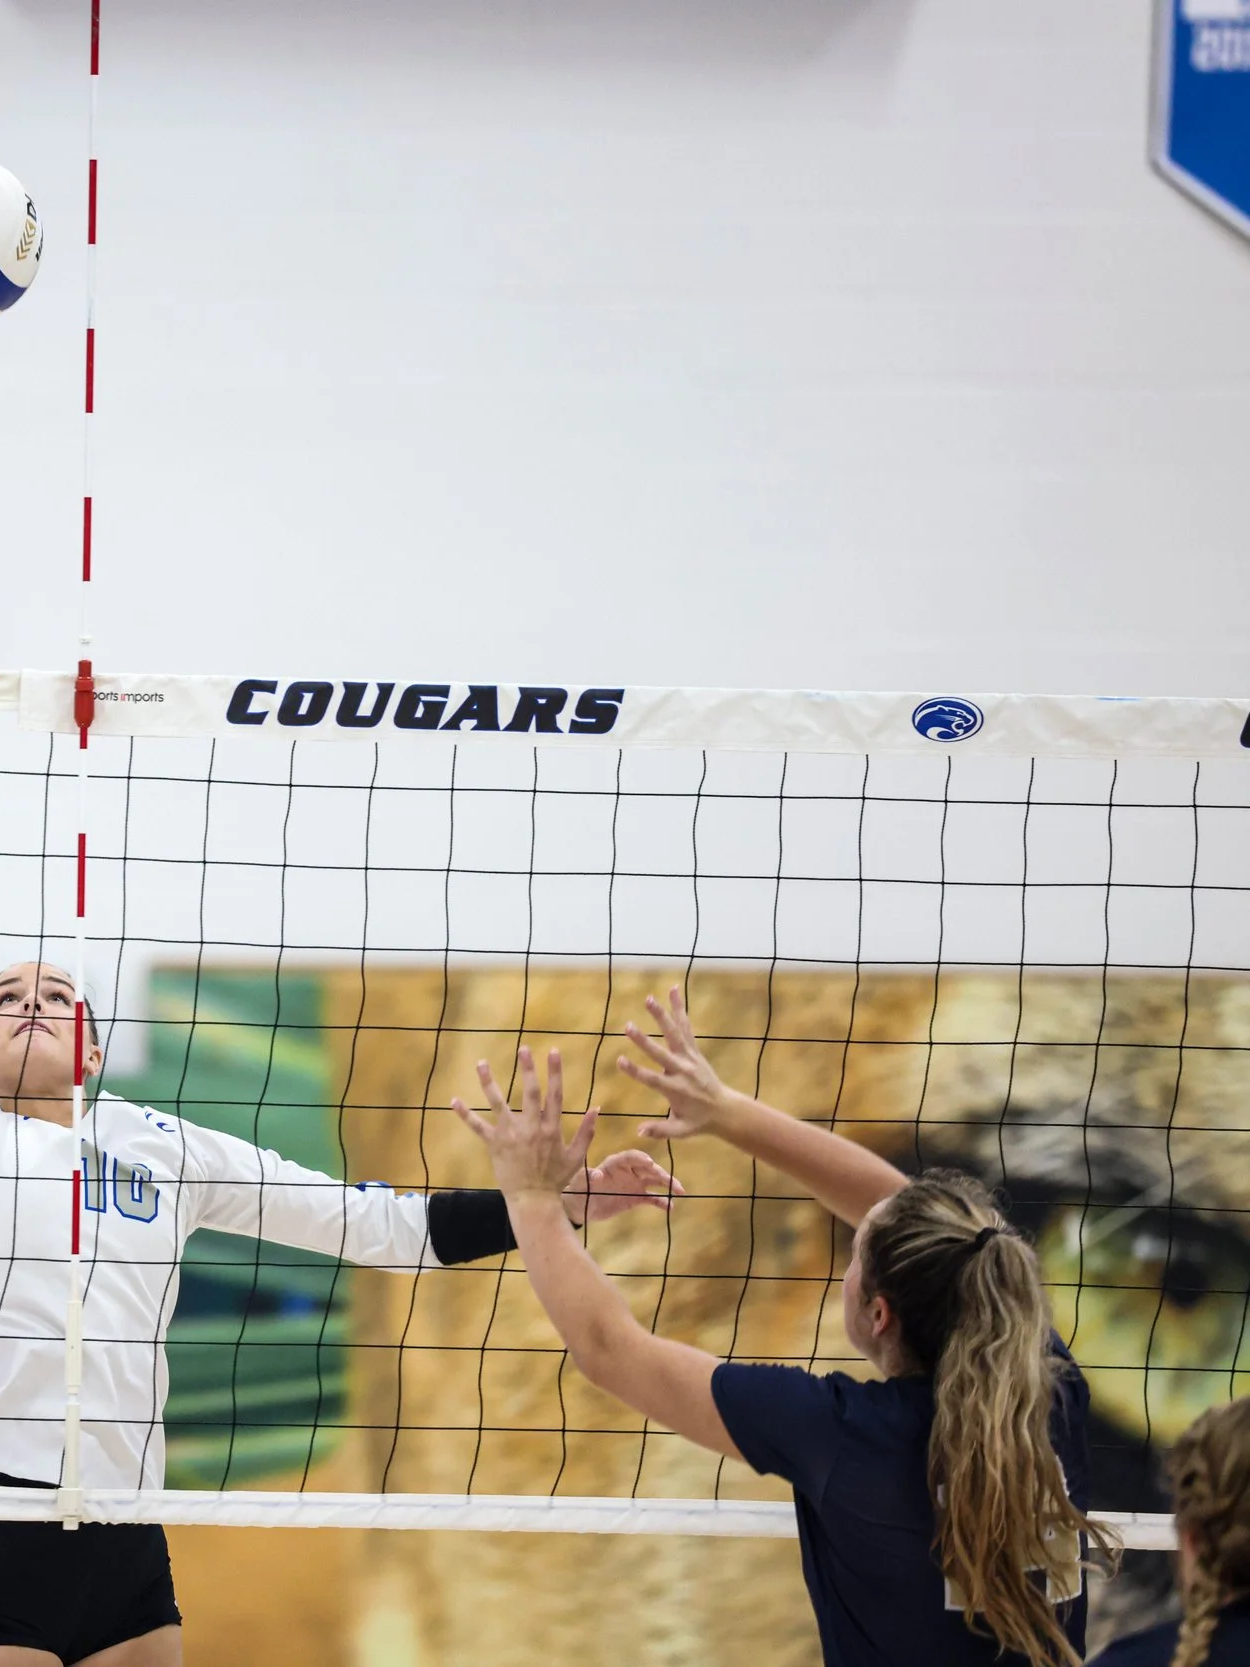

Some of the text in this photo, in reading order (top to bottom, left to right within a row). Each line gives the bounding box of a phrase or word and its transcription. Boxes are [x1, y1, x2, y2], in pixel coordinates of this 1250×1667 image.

[93, 691, 164, 703] orts imports
[226, 679, 626, 735] COUGARS
